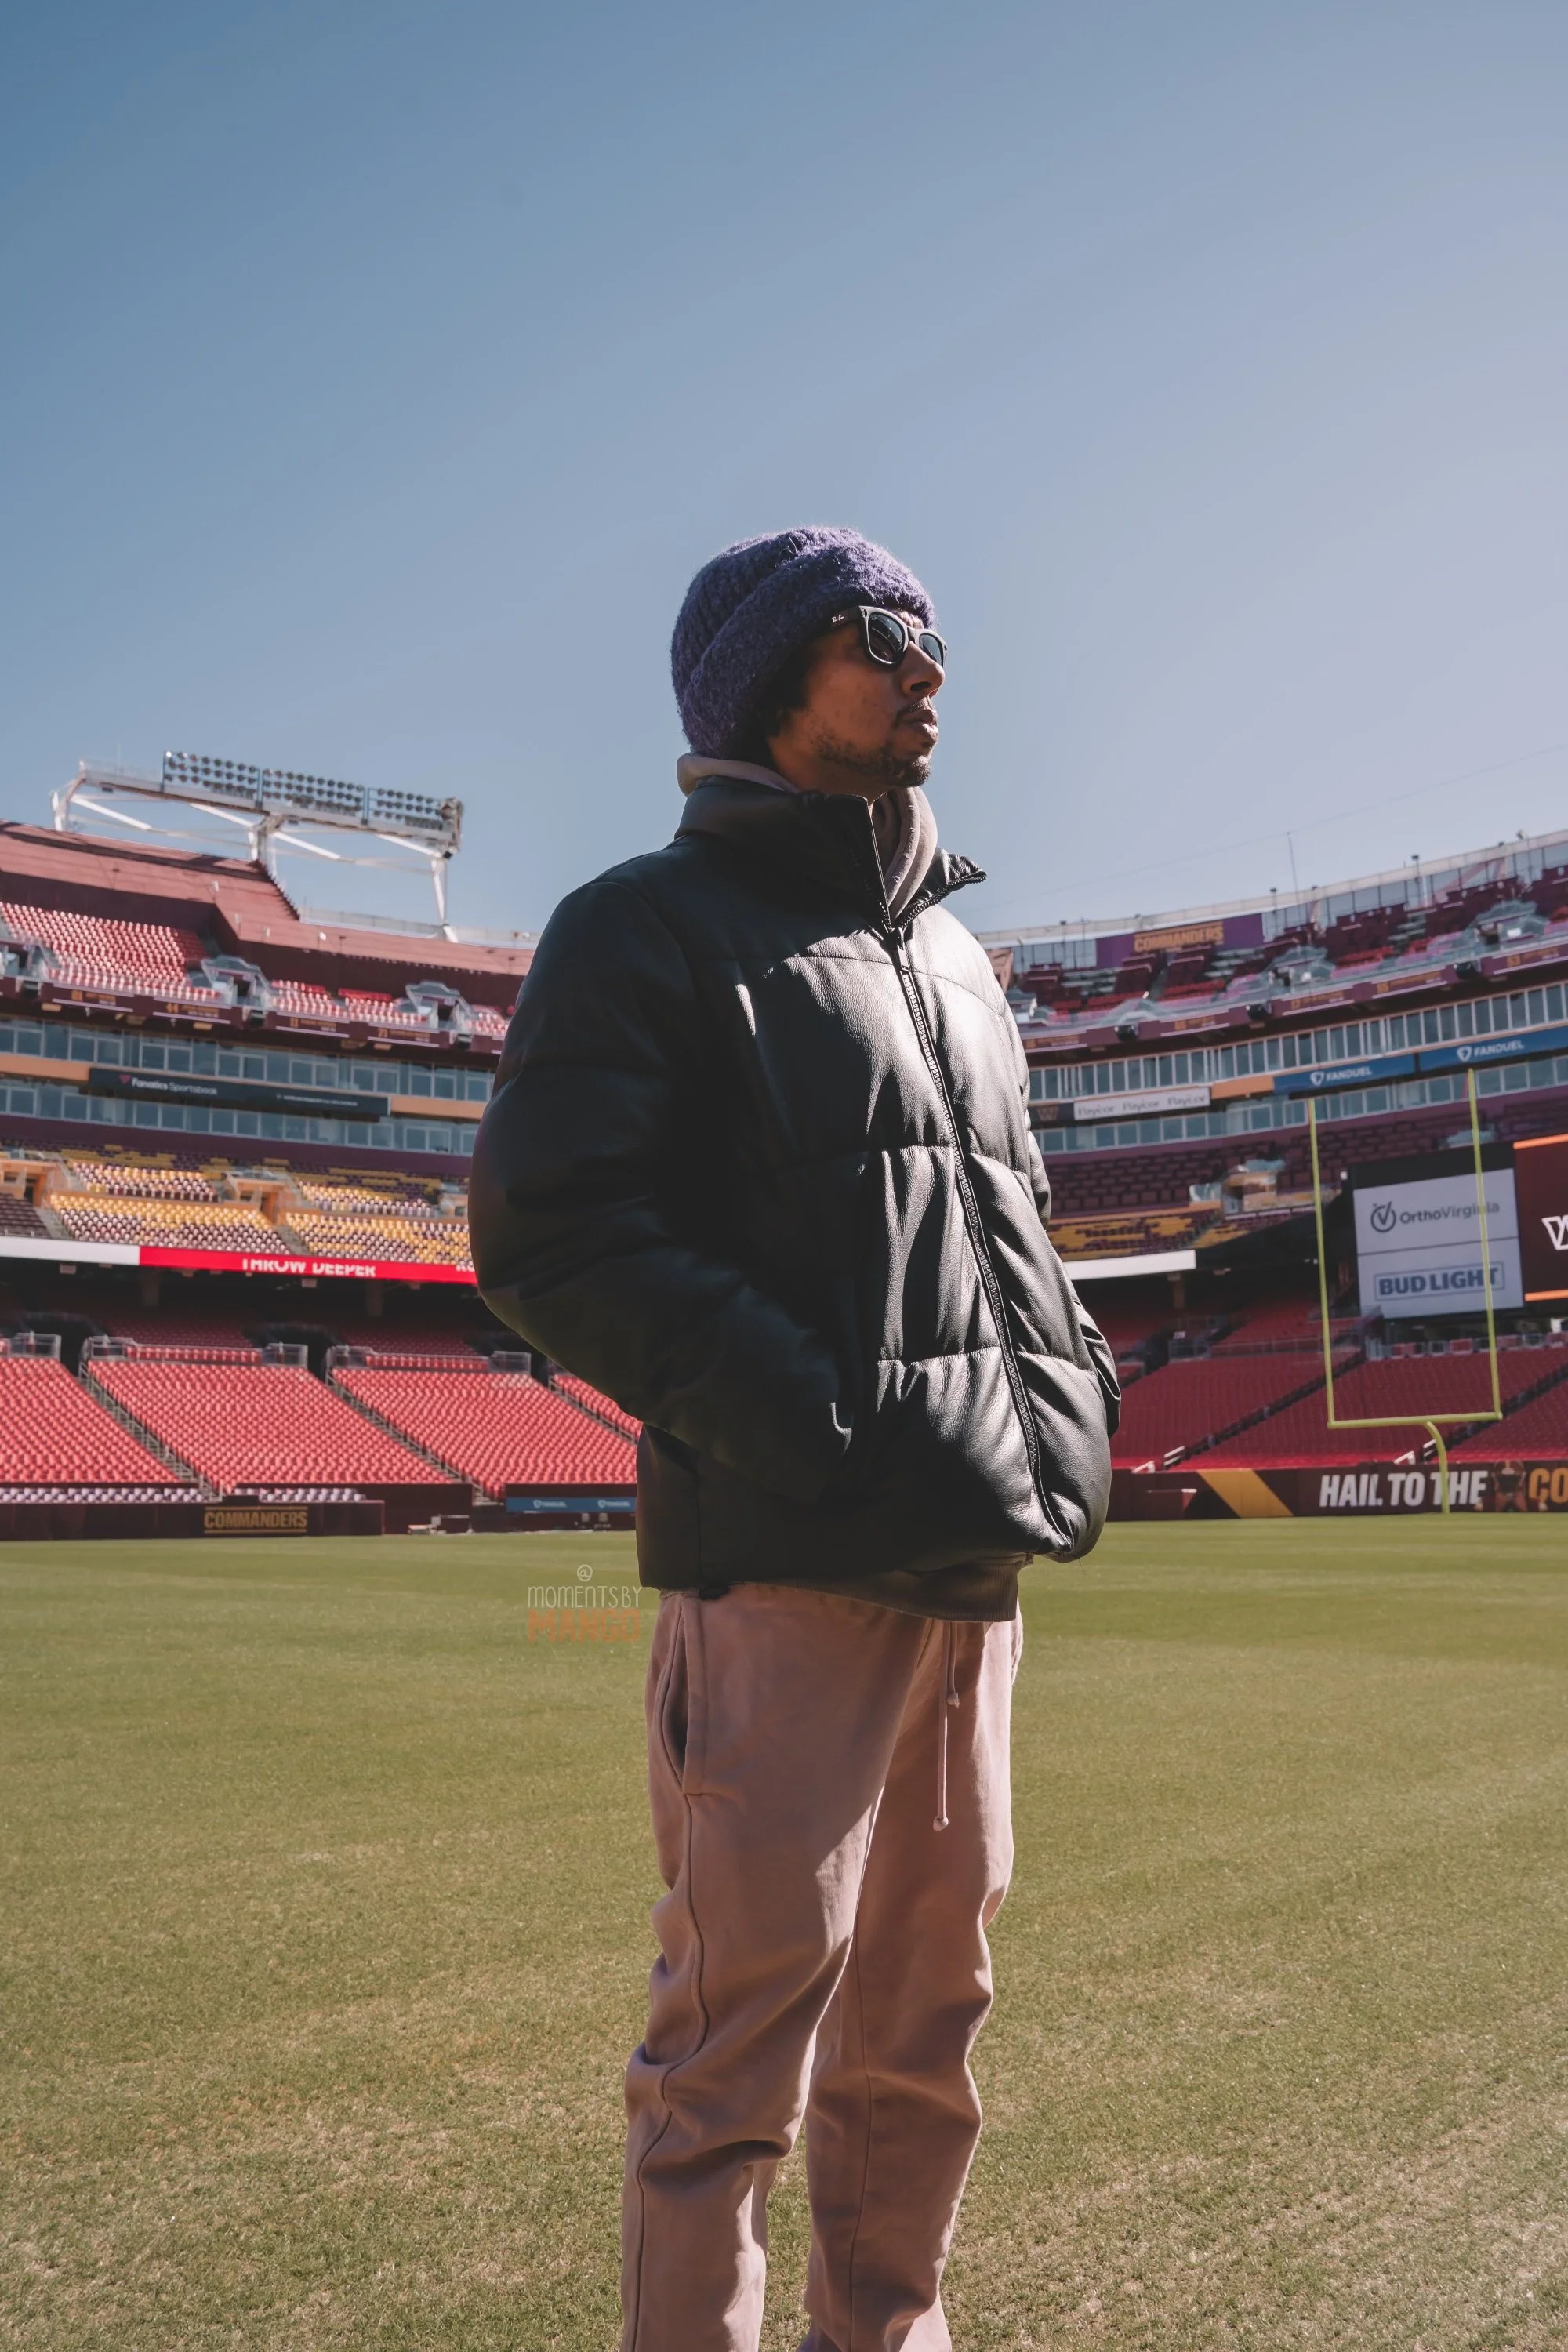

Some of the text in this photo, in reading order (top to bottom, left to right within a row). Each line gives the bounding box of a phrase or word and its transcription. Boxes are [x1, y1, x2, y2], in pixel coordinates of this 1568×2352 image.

[1134, 925, 1225, 953] COMMANDERS
[1473, 1040, 1525, 1058] FANDUEL
[1326, 1065, 1373, 1082] FANDUEL
[132, 1077, 217, 1095] Fanatics Sportsbook
[1078, 1094, 1206, 1117] Paycor Paycor Paycor
[1400, 1200, 1500, 1224] OrthoVirgiia
[1379, 1268, 1498, 1295] BUD LIGHT
[1319, 1467, 1568, 1507] HAIL TO THE CO
[204, 1512, 308, 1529] COMMANDERS
